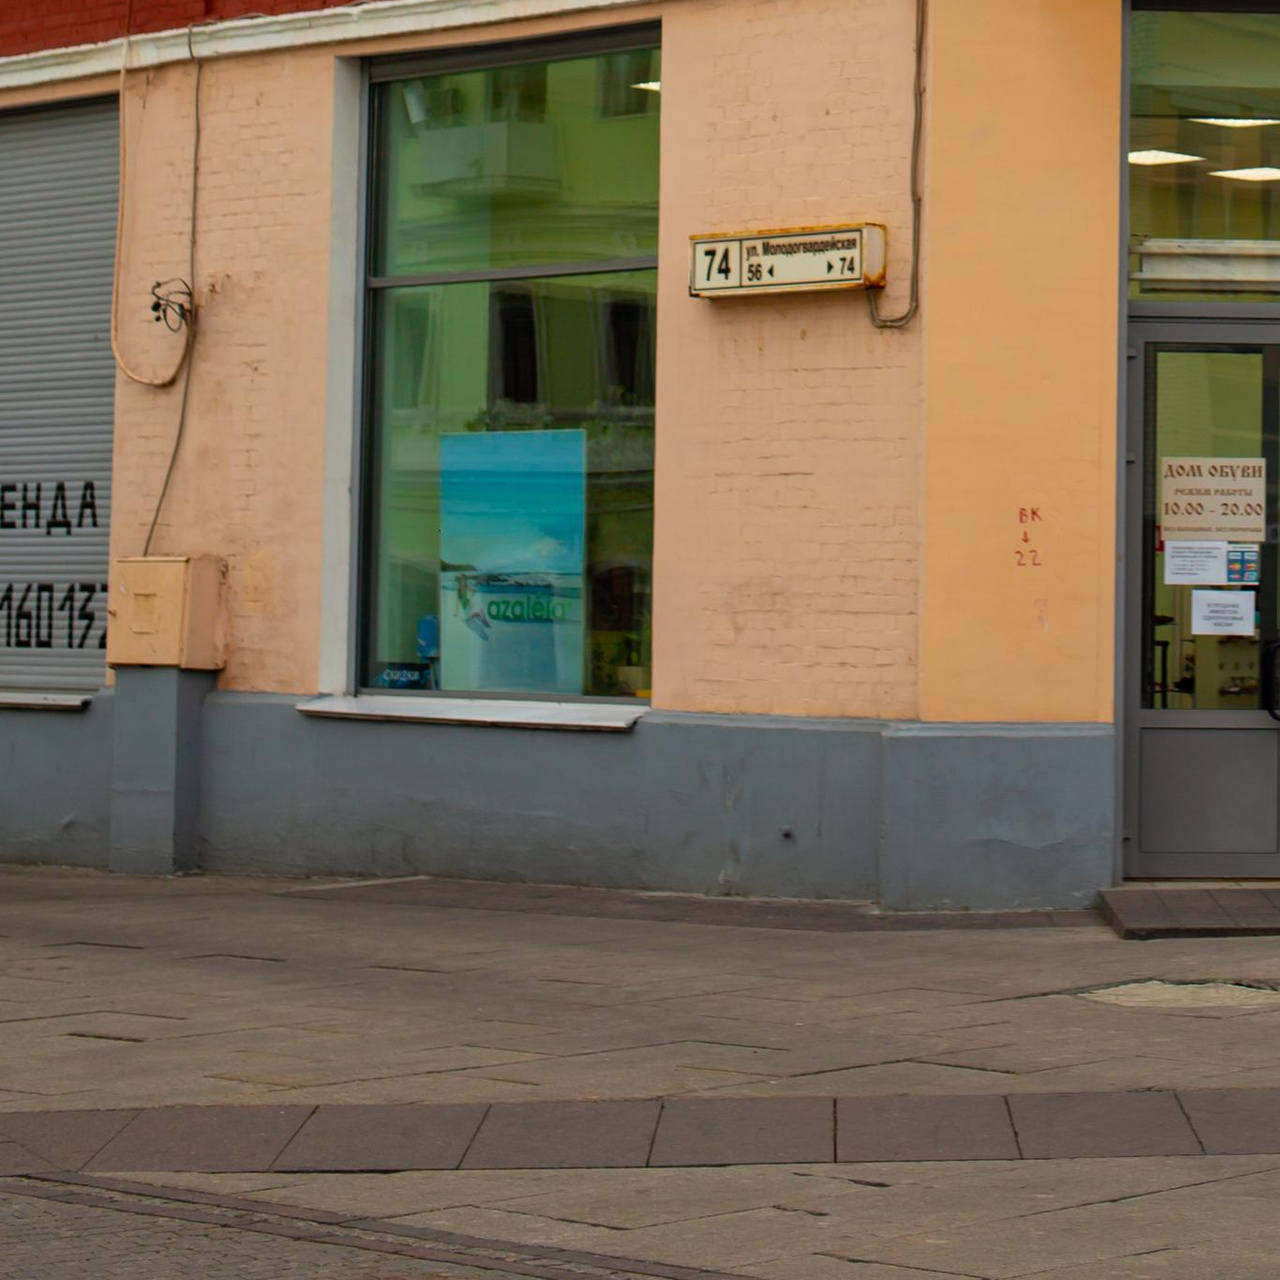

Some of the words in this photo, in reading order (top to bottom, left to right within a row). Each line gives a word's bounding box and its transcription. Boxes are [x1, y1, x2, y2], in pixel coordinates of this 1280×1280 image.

[745, 244, 759, 261] ул.
[762, 236, 857, 257] Молодогвардейская
[703, 247, 731, 282] 74
[747, 263, 762, 282] 56
[839, 256, 855, 276] 74
[1163, 463, 1204, 479] ДОМ
[1208, 464, 1263, 481] ОБУВИ
[1163, 502, 1204, 516] 10.00
[1220, 502, 1263, 516] 20.00
[1014, 549, 1042, 567] 22
